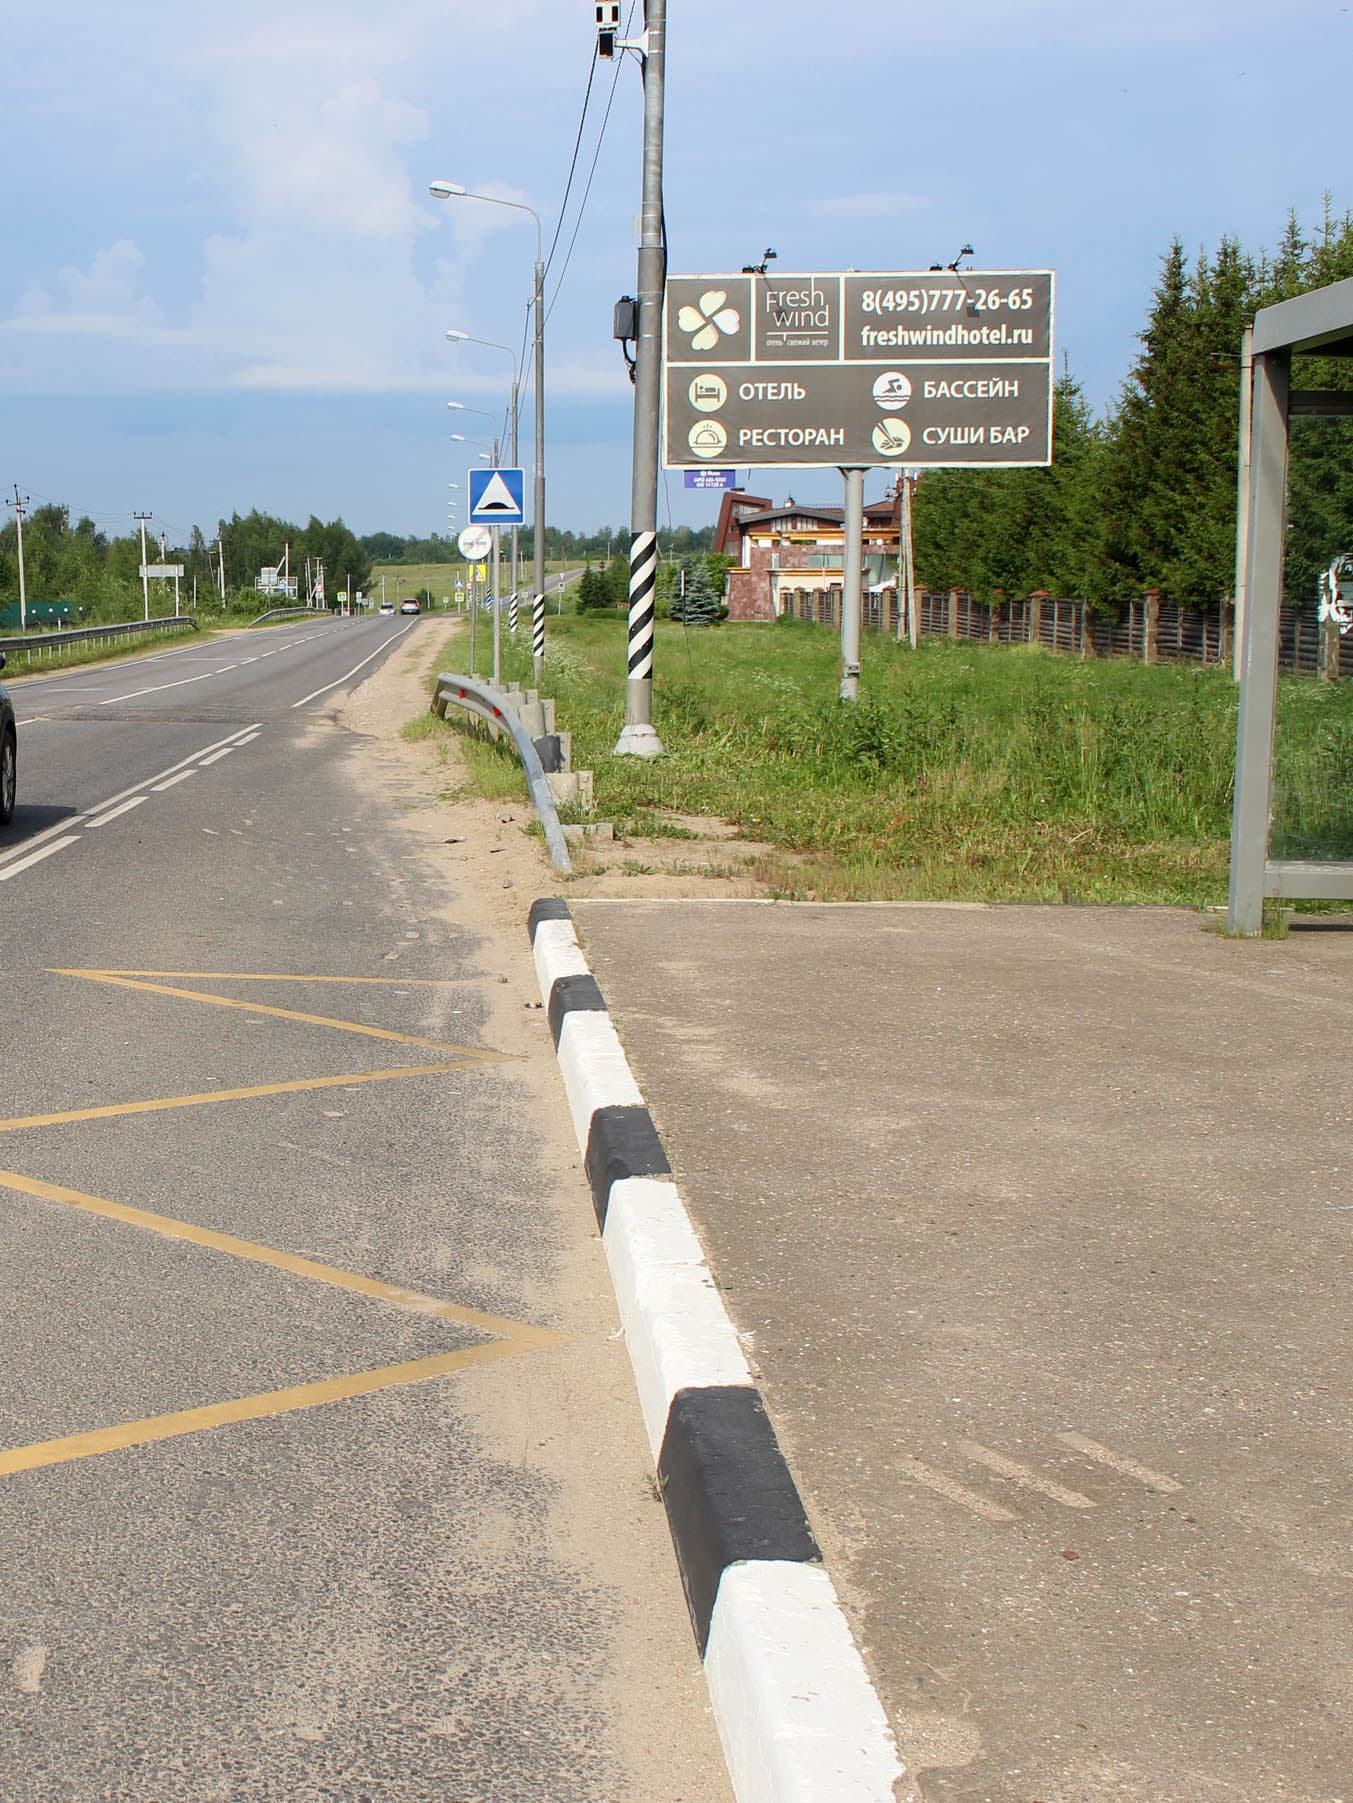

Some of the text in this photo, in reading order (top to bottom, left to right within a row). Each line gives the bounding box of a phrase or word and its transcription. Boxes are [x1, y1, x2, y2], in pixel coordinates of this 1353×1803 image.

[766, 284, 824, 313] Fresh
[861, 288, 1033, 315] 8(495)777-26-65
[773, 304, 829, 327] wind
[860, 324, 1033, 346] freshwindhotel.ru
[738, 382, 806, 401] ОТЕЛЬ
[923, 377, 1019, 399] БАССЕЙН
[738, 428, 845, 447] РЕСТОРАН
[922, 426, 1030, 445] СУШИ БАР
